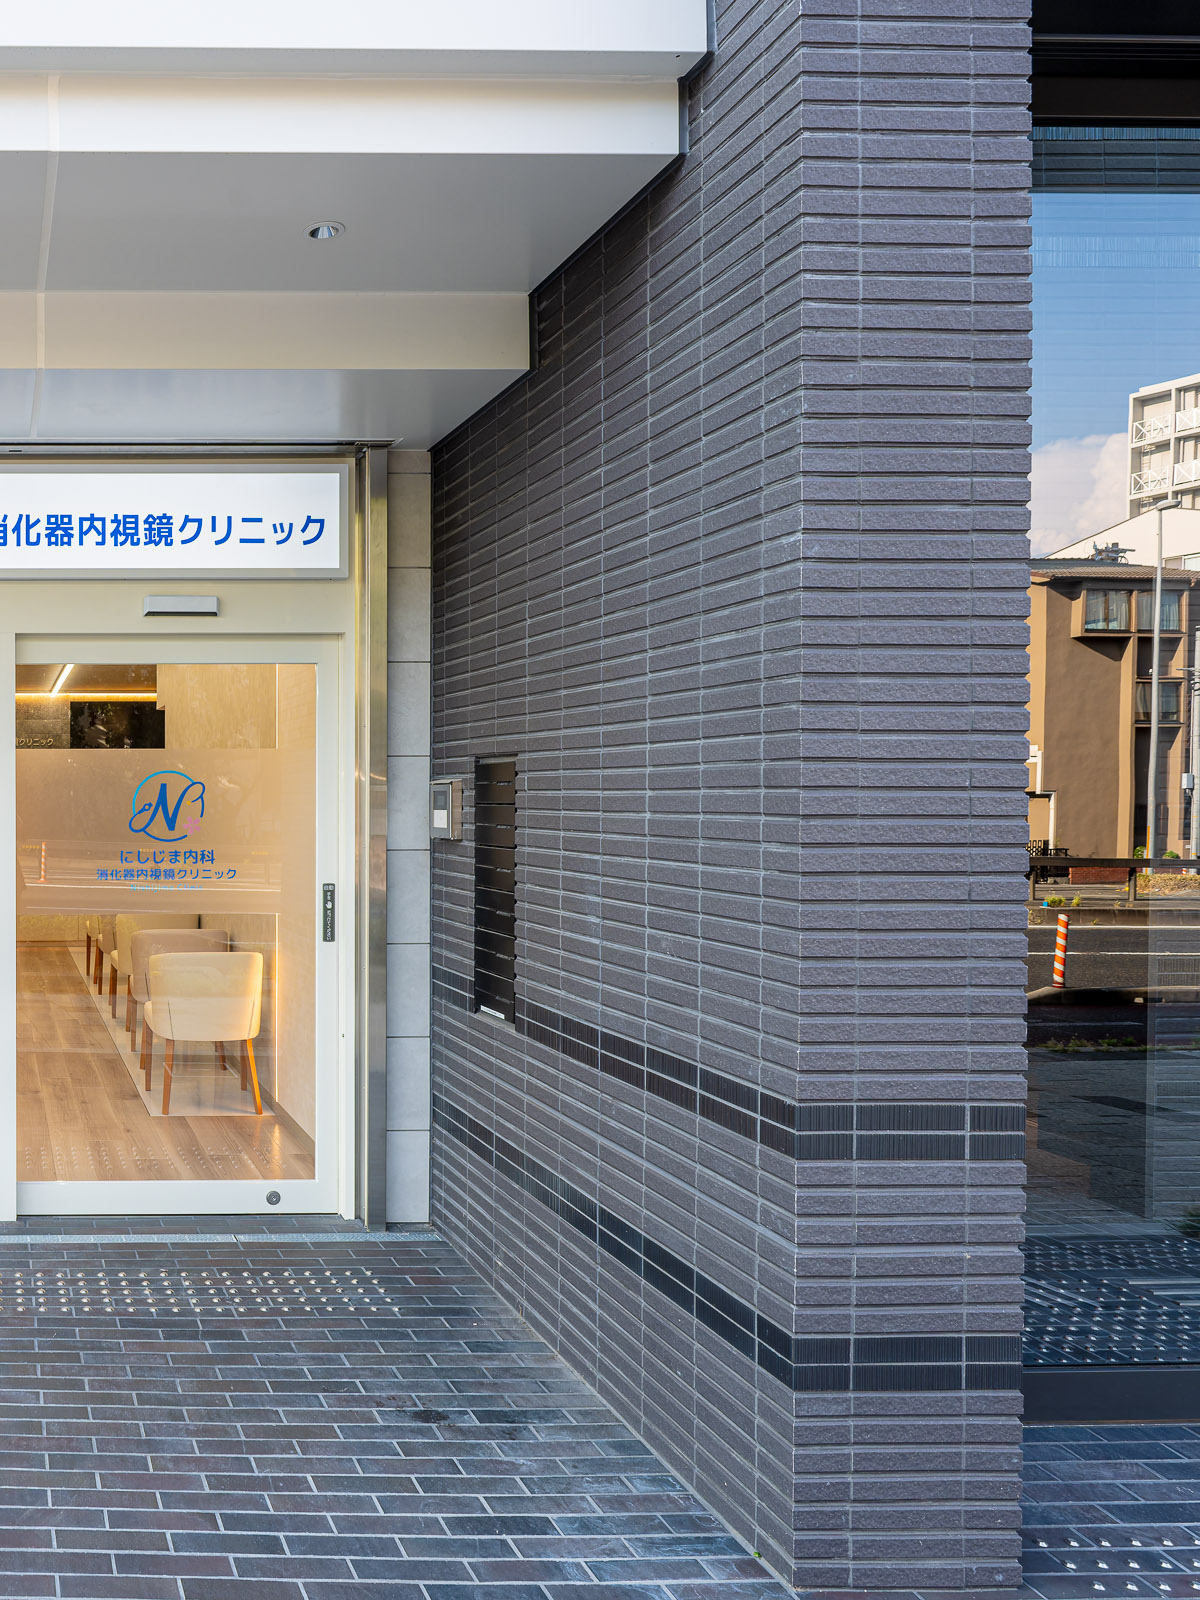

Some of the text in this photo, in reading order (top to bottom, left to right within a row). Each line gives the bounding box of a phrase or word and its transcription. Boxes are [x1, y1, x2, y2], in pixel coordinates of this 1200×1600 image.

[120, 849, 215, 864] にしじま内科
[97, 868, 237, 880] 消化器内視鏡クリニック
